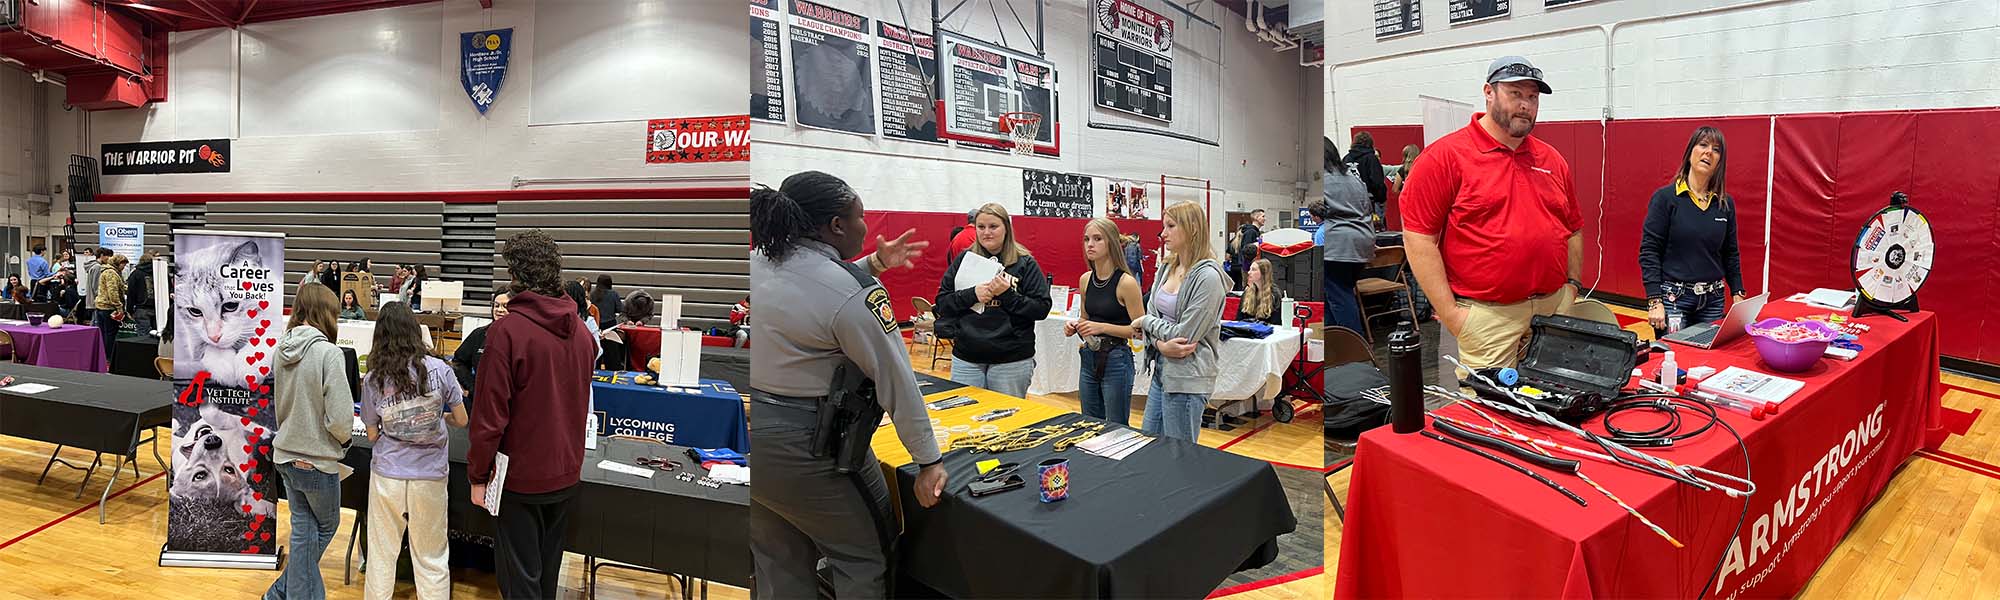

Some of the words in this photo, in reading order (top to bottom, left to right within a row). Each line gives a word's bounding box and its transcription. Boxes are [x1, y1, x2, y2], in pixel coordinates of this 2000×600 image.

[1120, 2, 1136, 16] HOME
[1137, 9, 1144, 19] OF
[1145, 12, 1154, 24] THE
[798, 18, 824, 30] LEAGUE
[825, 24, 862, 40] CHAMPIONS
[1122, 18, 1152, 37] MONITEAU
[1122, 28, 1152, 48] WARRIORS
[678, 132, 718, 148] OUR
[104, 152, 123, 166] THE
[126, 150, 175, 166] WARRIOR
[180, 148, 196, 164] PIT
[118, 228, 137, 237] Oberg
[220, 265, 270, 279] Career
[610, 417, 674, 433] LYCOMING
[615, 428, 674, 442] COLLEGE
[1715, 403, 1884, 595] ARMSTRONG
[1740, 552, 1780, 594] support
[1782, 507, 1818, 557] Armstrong
[1819, 493, 1832, 514] you
[1832, 468, 1854, 495] support
